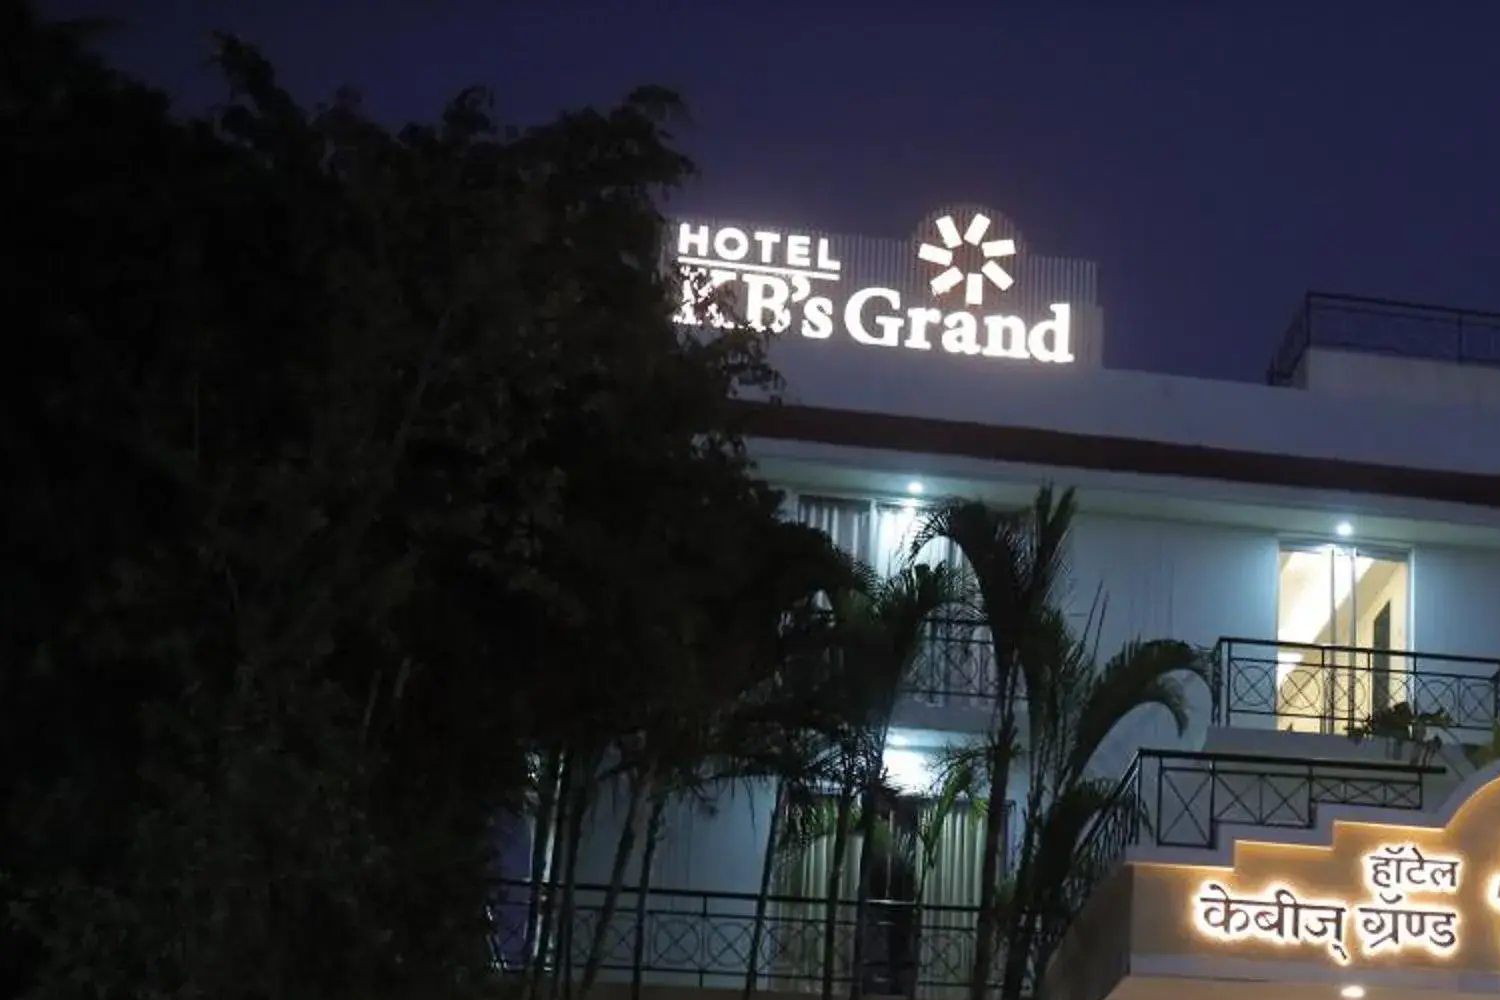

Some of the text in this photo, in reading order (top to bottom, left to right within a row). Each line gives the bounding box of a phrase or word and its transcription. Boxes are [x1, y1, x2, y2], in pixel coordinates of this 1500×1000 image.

[677, 223, 841, 271] HOTEL
[673, 265, 1075, 364] KB's Grand
[1369, 846, 1460, 888] हॉटेल
[1199, 883, 1348, 960] केबीज्
